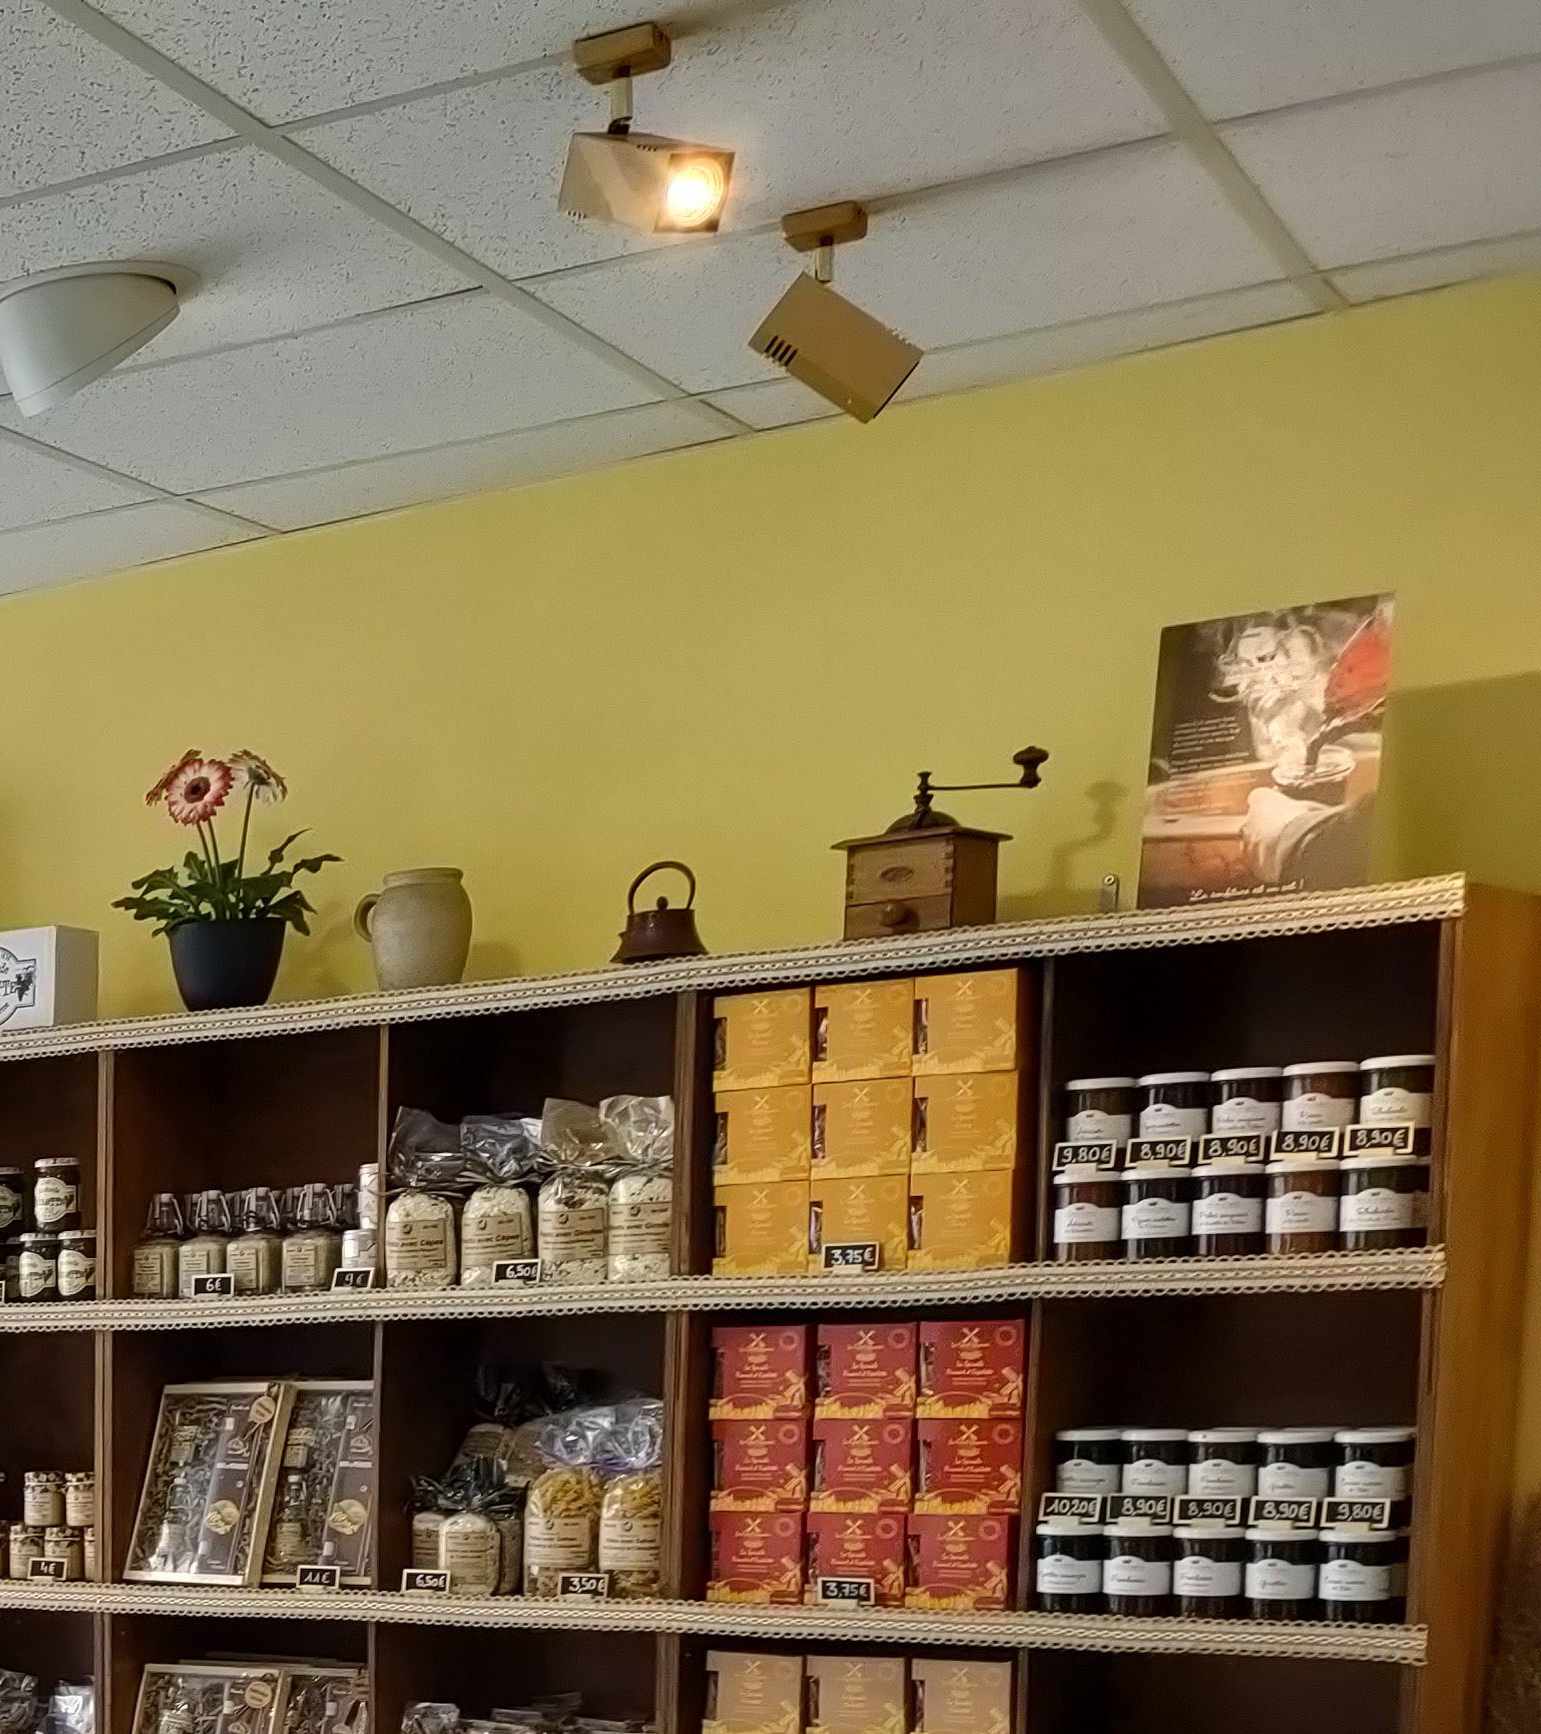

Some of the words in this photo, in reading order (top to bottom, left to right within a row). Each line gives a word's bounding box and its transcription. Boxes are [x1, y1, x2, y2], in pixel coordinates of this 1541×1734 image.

[1281, 1133, 1330, 1153] 8,90€
[1355, 1128, 1404, 1148] 8,90€
[1061, 1145, 1112, 1164] 9,80€
[1140, 1141, 1186, 1160] 8,90€
[1208, 1139, 1258, 1158] 8,90€
[830, 1247, 874, 1265] 3,75€
[344, 1273, 365, 1287] 9€
[506, 1265, 538, 1278] 6,50€
[205, 1277, 223, 1291] 6€
[1047, 1497, 1097, 1516] 10,20€
[1121, 1497, 1167, 1517] 8,90€
[1188, 1500, 1234, 1518] 8,90€
[1262, 1502, 1309, 1520] 8,90€
[1337, 1503, 1382, 1520] 9,80€
[39, 1561, 56, 1575] 4€
[304, 1571, 330, 1585] 11€
[415, 1574, 446, 1589] 6,50€
[568, 1578, 604, 1594] 3,50€
[825, 1582, 868, 1598] 3,75€
